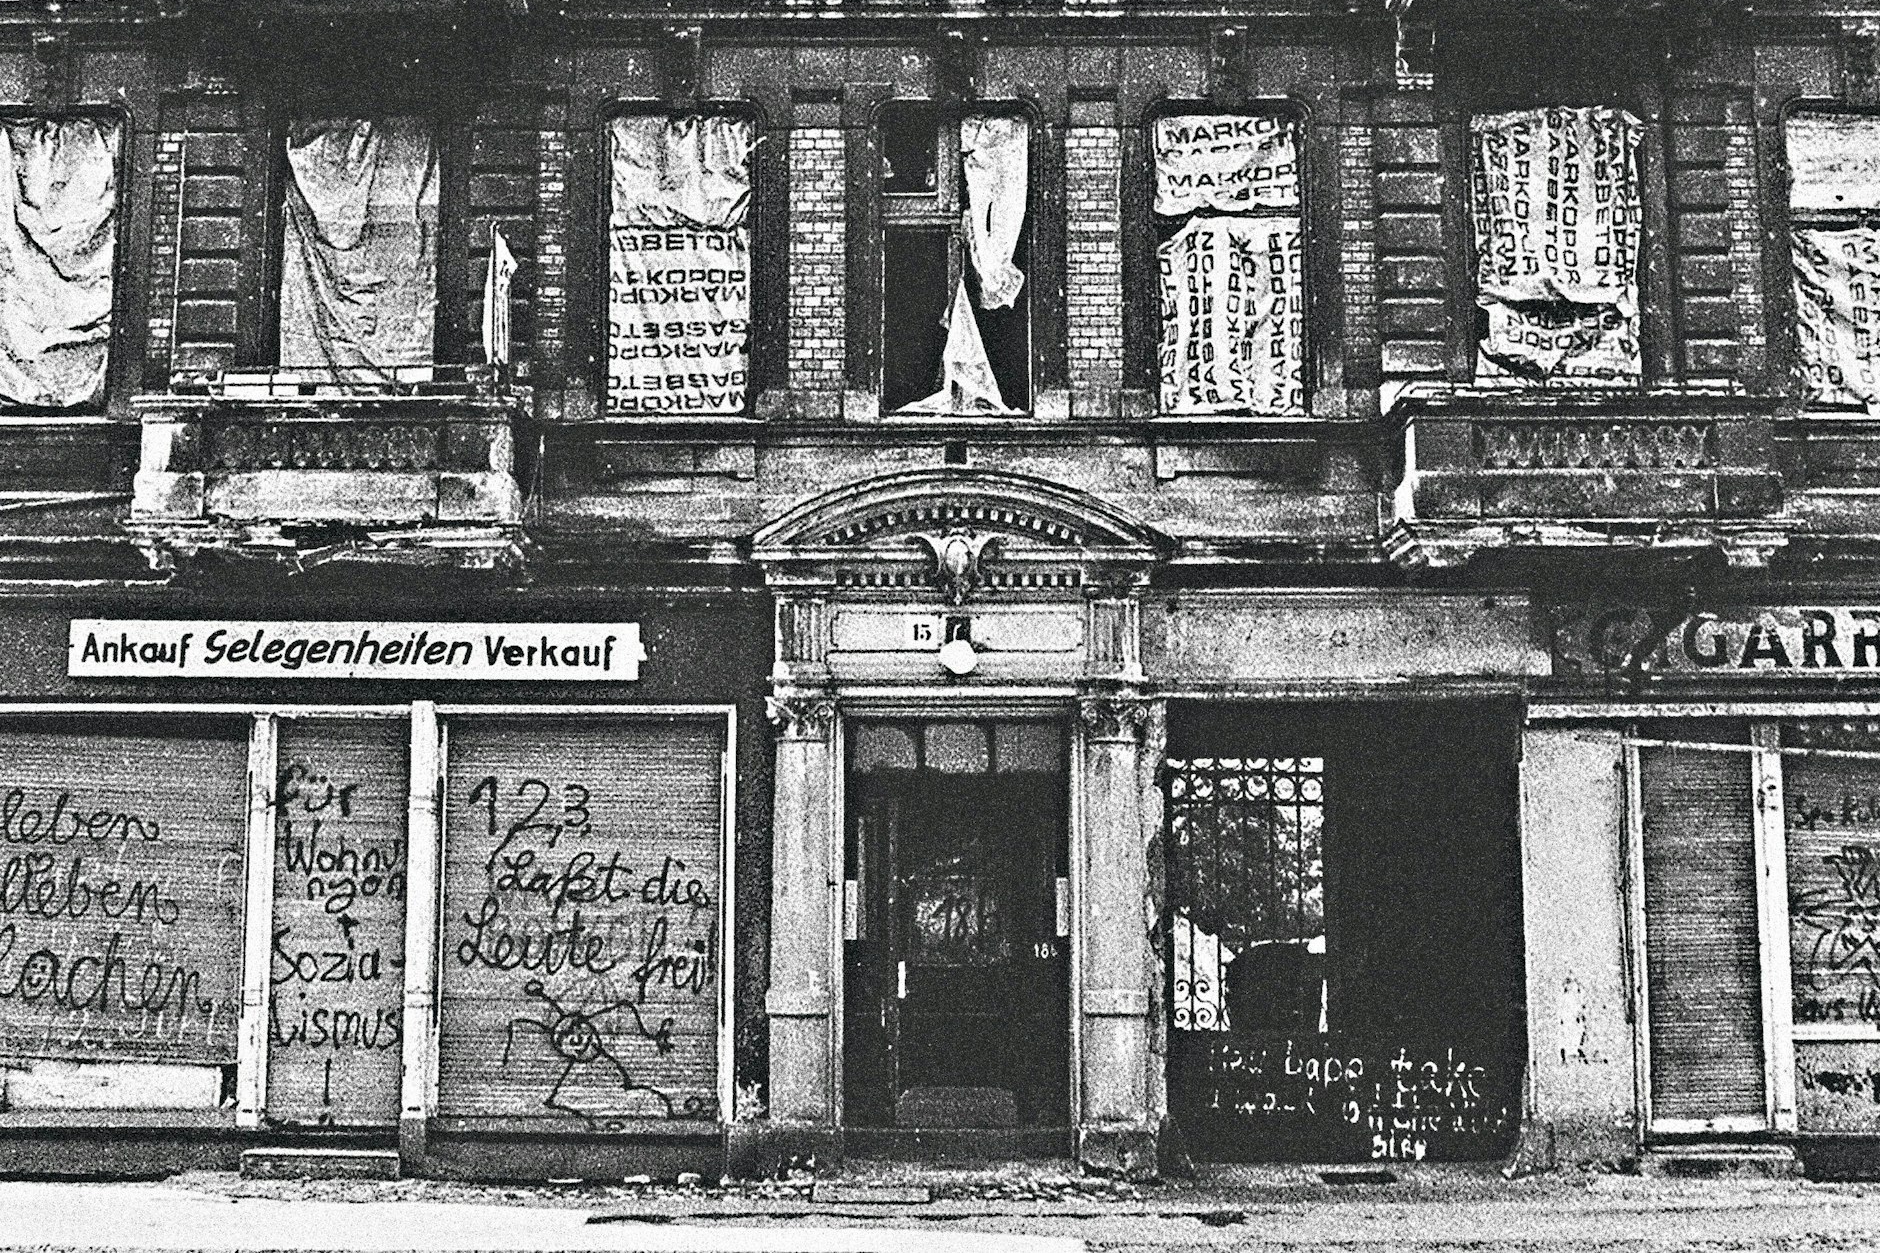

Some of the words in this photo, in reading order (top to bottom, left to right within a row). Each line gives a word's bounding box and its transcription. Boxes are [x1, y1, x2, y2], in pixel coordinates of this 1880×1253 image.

[912, 623, 932, 641] 15
[81, 632, 193, 668] Ankauf
[485, 635, 617, 671] Verkauf
